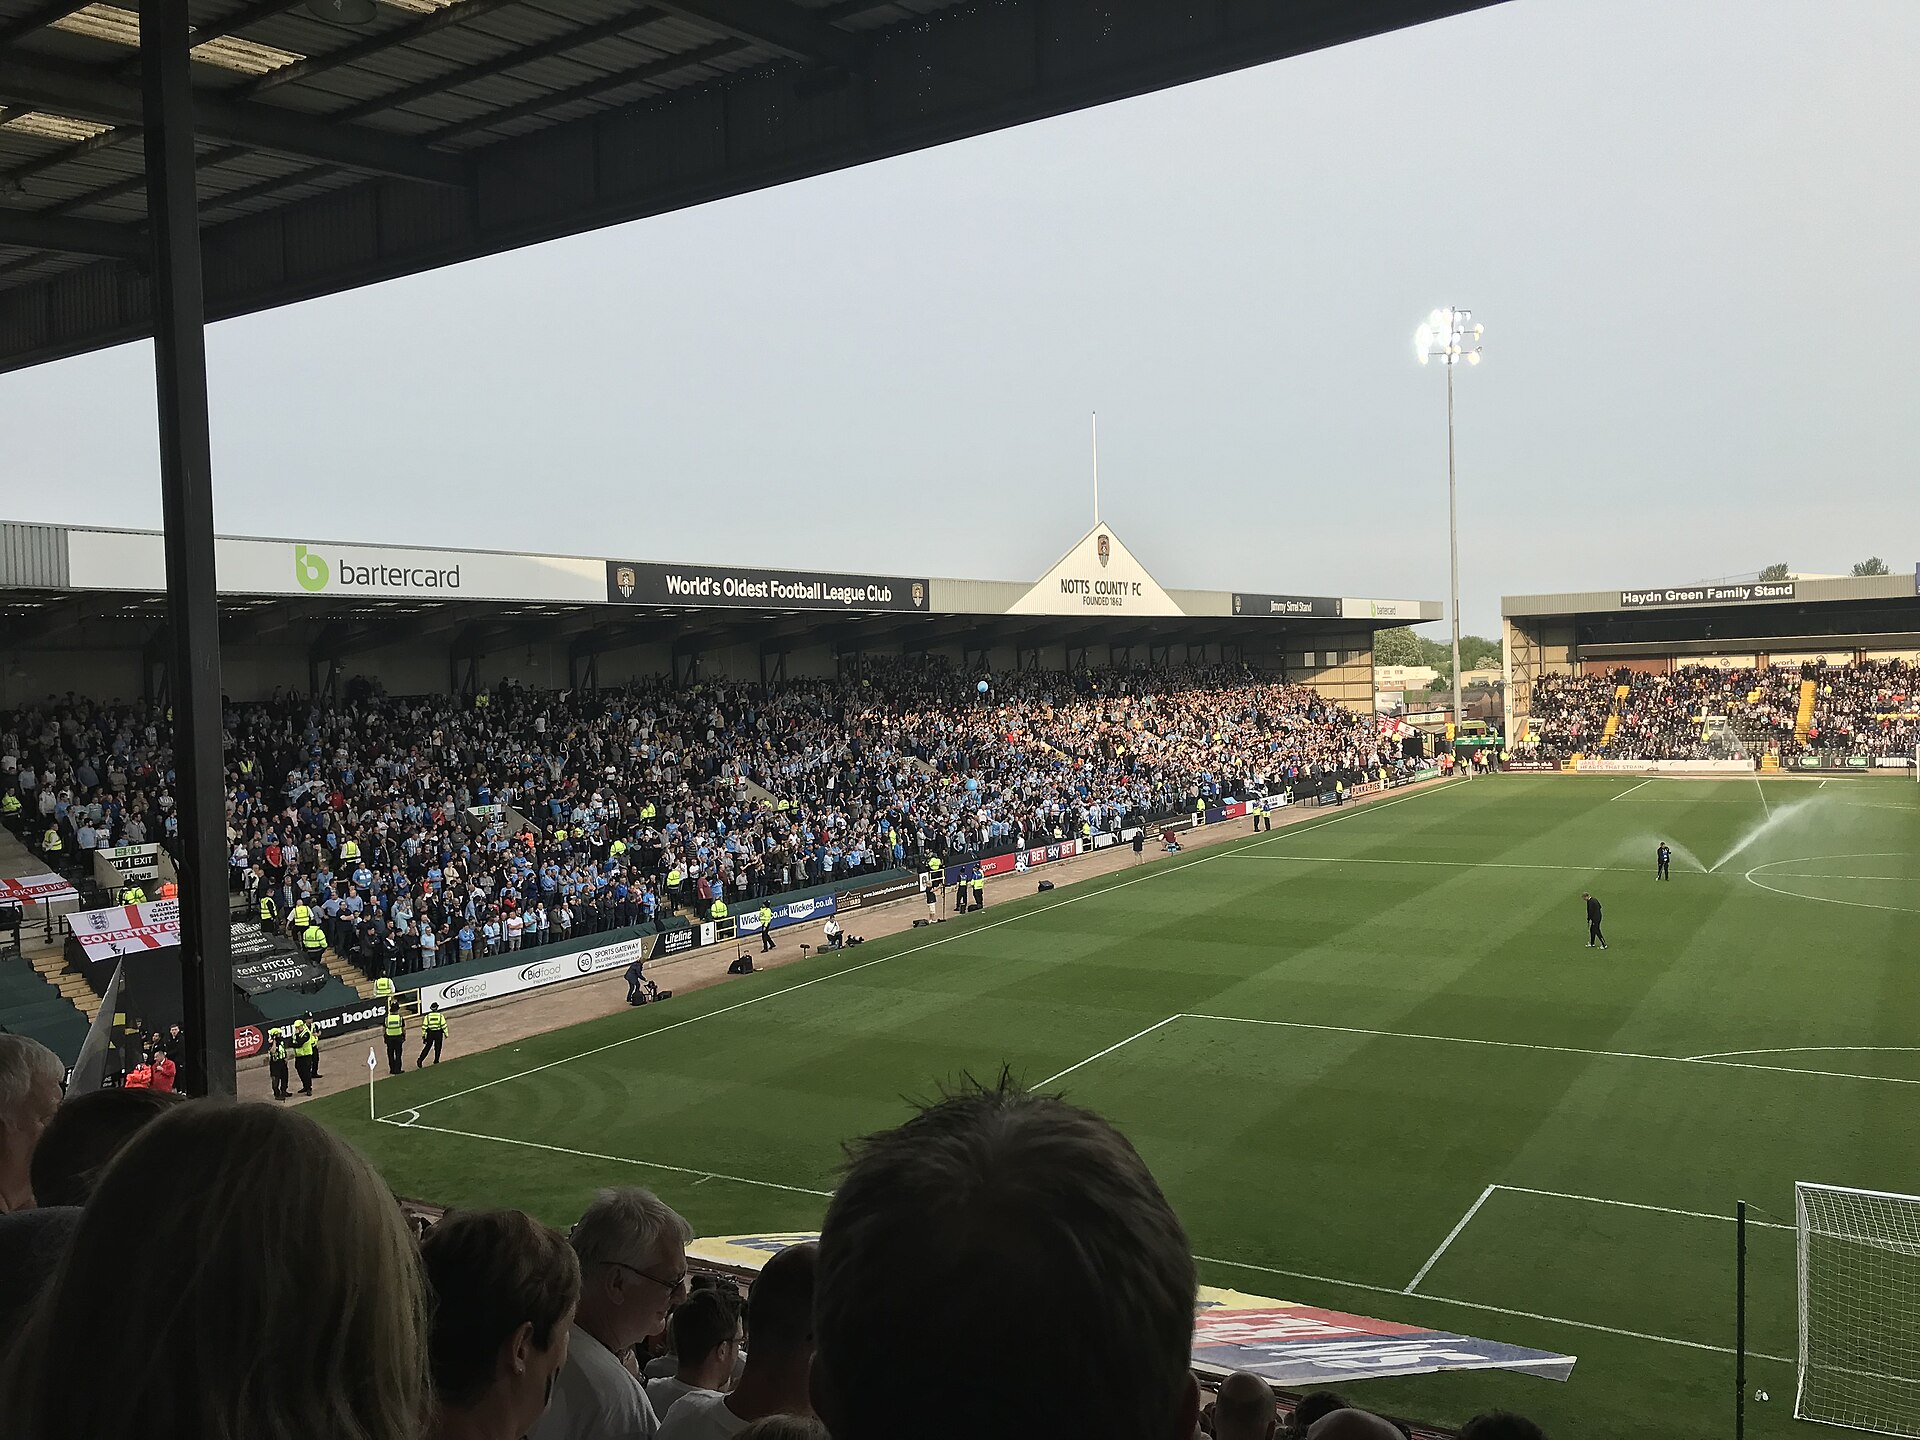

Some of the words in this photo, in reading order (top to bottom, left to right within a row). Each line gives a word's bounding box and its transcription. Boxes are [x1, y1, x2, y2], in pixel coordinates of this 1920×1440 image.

[339, 559, 461, 588] bartercard
[665, 574, 721, 597] World's
[723, 578, 769, 598] Oldest
[771, 580, 821, 600] Football
[823, 582, 865, 604] League
[866, 584, 892, 602] Club
[1060, 578, 1090, 594] NOTTS
[1095, 580, 1128, 596] COUNTY
[1132, 582, 1142, 596] FC
[1622, 592, 1662, 605] Haydn
[1665, 590, 1703, 601] Green
[1707, 587, 1750, 600] Family
[1754, 584, 1793, 597] Stand
[1082, 596, 1109, 606] FOUNDED
[1110, 597, 1122, 606] 1862
[1270, 601, 1287, 614] Jimmy
[1299, 602, 1312, 613] Stand
[1377, 605, 1396, 615] bartercard
[1031, 849, 1045, 862] BET
[1048, 845, 1060, 859] sky
[1061, 843, 1074, 855] BET
[134, 856, 153, 865] EXIT
[13, 887, 34, 896] SKY
[80, 926, 161, 945] COVENTRY
[665, 930, 693, 945] Lifeline
[594, 948, 614, 959] SPORTS
[614, 942, 639, 954] GATEWAY
[236, 965, 262, 976] text:
[261, 957, 295, 971] FITC16
[272, 968, 303, 982] 70070
[527, 963, 561, 981] Bidfood
[450, 981, 487, 999] Bidfood
[342, 1005, 386, 1025] boots
